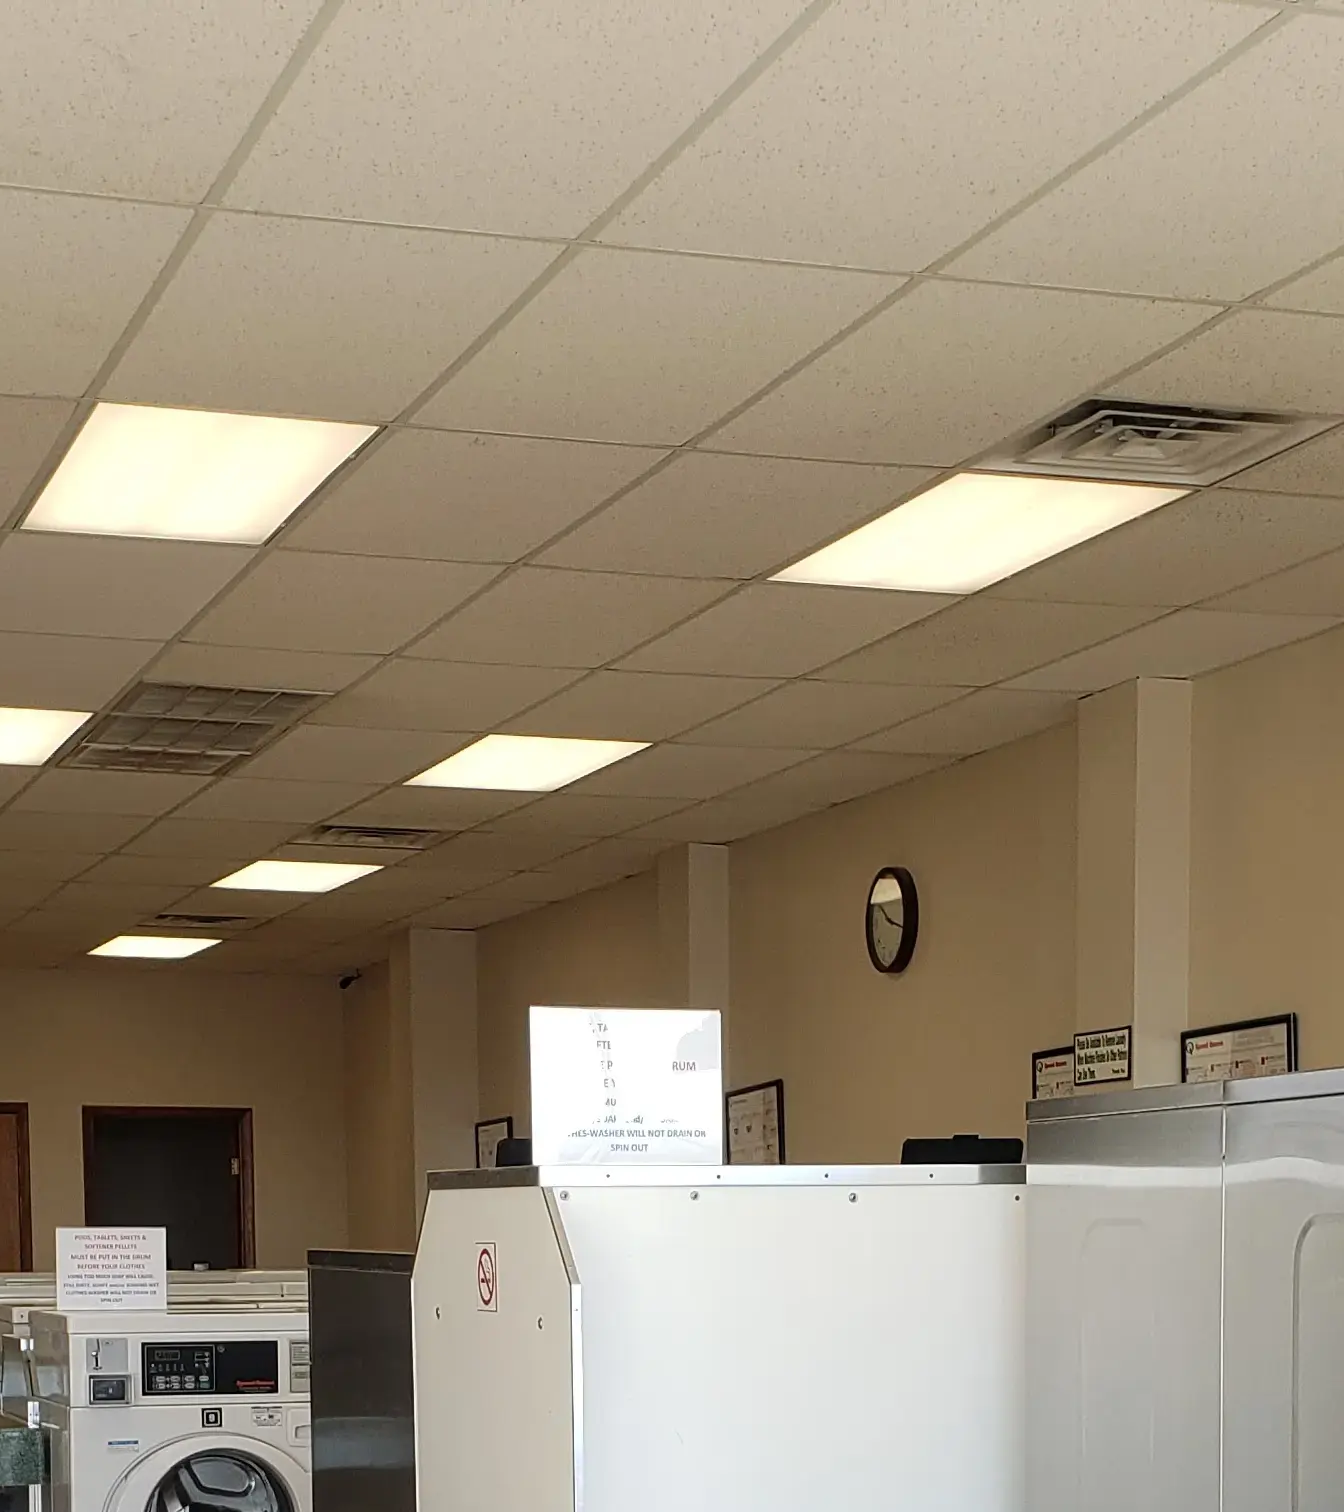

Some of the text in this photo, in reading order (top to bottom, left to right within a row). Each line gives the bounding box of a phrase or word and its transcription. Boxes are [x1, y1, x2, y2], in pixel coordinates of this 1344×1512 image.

[672, 1061, 696, 1071] RUM
[667, 1130, 693, 1138] DRAIN
[610, 1144, 649, 1152] SPIN OUT
